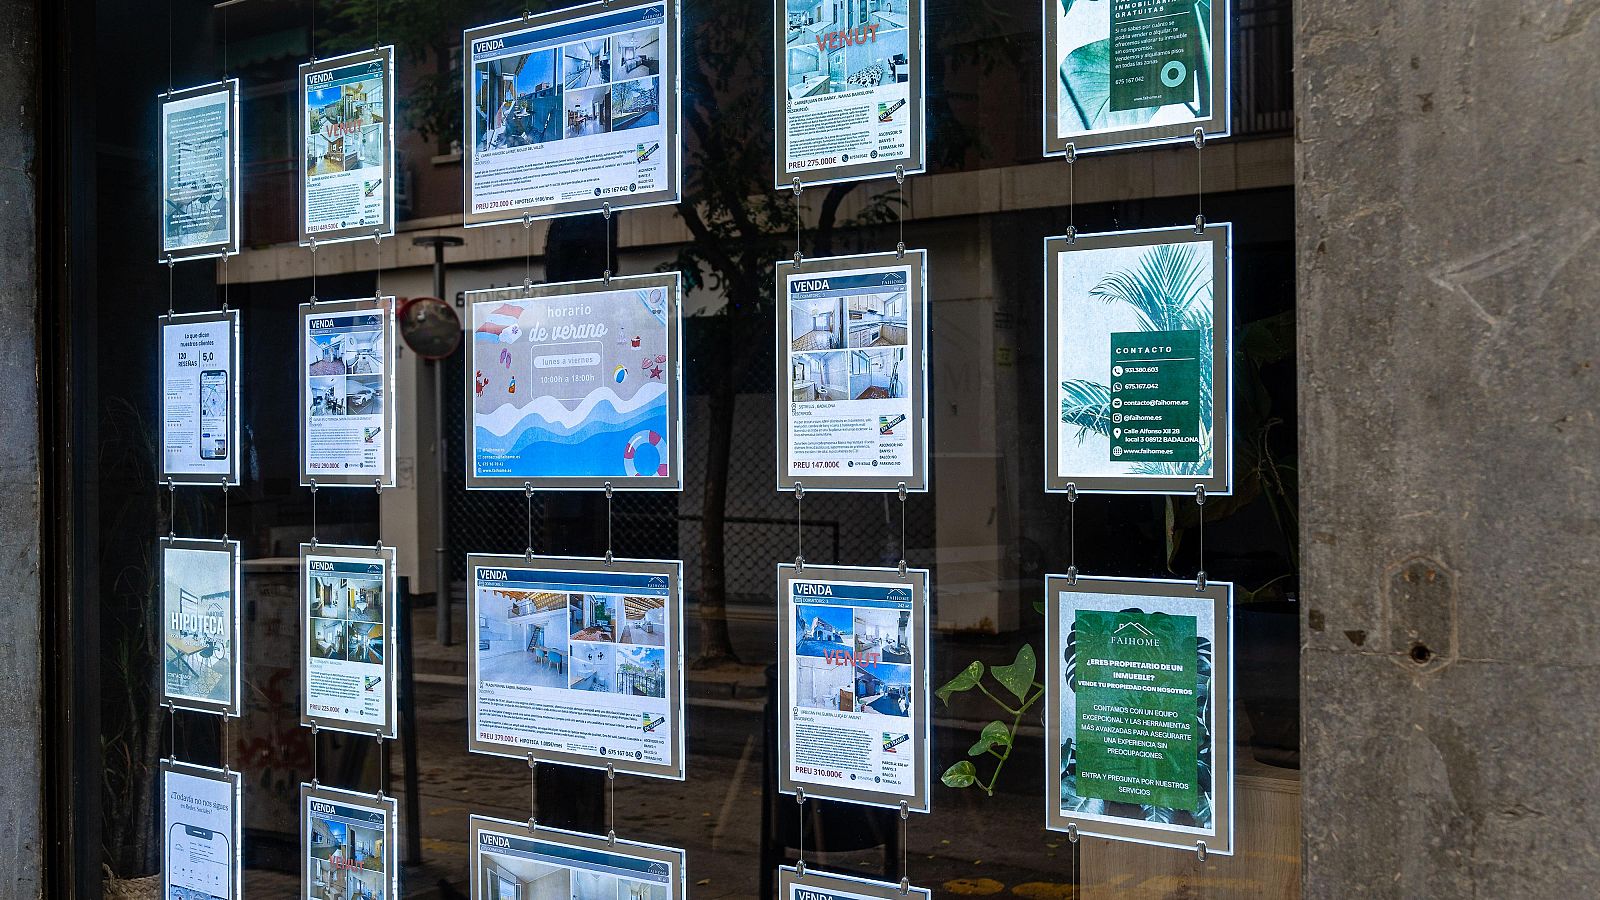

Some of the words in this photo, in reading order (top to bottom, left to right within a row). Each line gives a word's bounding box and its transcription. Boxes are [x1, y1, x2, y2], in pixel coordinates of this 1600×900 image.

[1115, 0, 1177, 10] INMOBILIAR
[1115, 6, 1164, 18] GRATUITAS
[816, 24, 879, 51] VENUT
[476, 39, 504, 52] VENDA
[1115, 53, 1140, 62] Vendemos
[309, 72, 333, 84] VENDA
[326, 119, 362, 137] VENUT
[788, 160, 805, 169] PREU
[808, 157, 836, 167] 275.000€
[794, 280, 829, 292] VENDA
[547, 304, 591, 318] horario
[311, 319, 334, 328] VENDA
[529, 322, 548, 342] de
[552, 322, 608, 340] verano
[203, 353, 213, 363] 5,0
[311, 561, 334, 571] VENDA
[480, 570, 508, 580] VENDA
[796, 584, 832, 595] VENDA
[171, 612, 224, 635] HIPOTECA
[1111, 636, 1160, 646] FAIHOME
[823, 648, 880, 669] VENUT
[1087, 659, 1108, 667] ¿ERES
[1110, 660, 1160, 670] PROPIETARIO
[1161, 663, 1170, 671] DE
[1113, 672, 1155, 681] INMUEBLE?
[1107, 683, 1141, 691] PROPIEDAD
[1157, 686, 1193, 695] NOSOTROS
[1094, 705, 1128, 714] CONTAMOS
[1130, 707, 1143, 715] CON
[1155, 709, 1178, 717] EQUIPO
[1083, 714, 1123, 724] EXCEPCIONAL
[1143, 719, 1190, 729] HERRAMIENTAS
[480, 732, 493, 740] PREU
[1081, 723, 1094, 732] MÁS
[1095, 726, 1132, 735] AVANZADAS
[1133, 729, 1149, 737] PARA
[1150, 730, 1192, 740] ASEGURARTE
[1103, 737, 1117, 745] UNA
[1118, 738, 1156, 748] EXPERIENCIA
[795, 766, 812, 775] PREU
[814, 768, 842, 778] 310.000€
[1082, 771, 1101, 780] ENTRA
[1108, 774, 1140, 784] PREGUNTA
[1142, 778, 1154, 786] POR
[1155, 779, 1189, 789] NUESTROS
[1119, 786, 1151, 796] SERVICIOS
[312, 802, 336, 814] VENDA
[482, 834, 510, 848] VENDA
